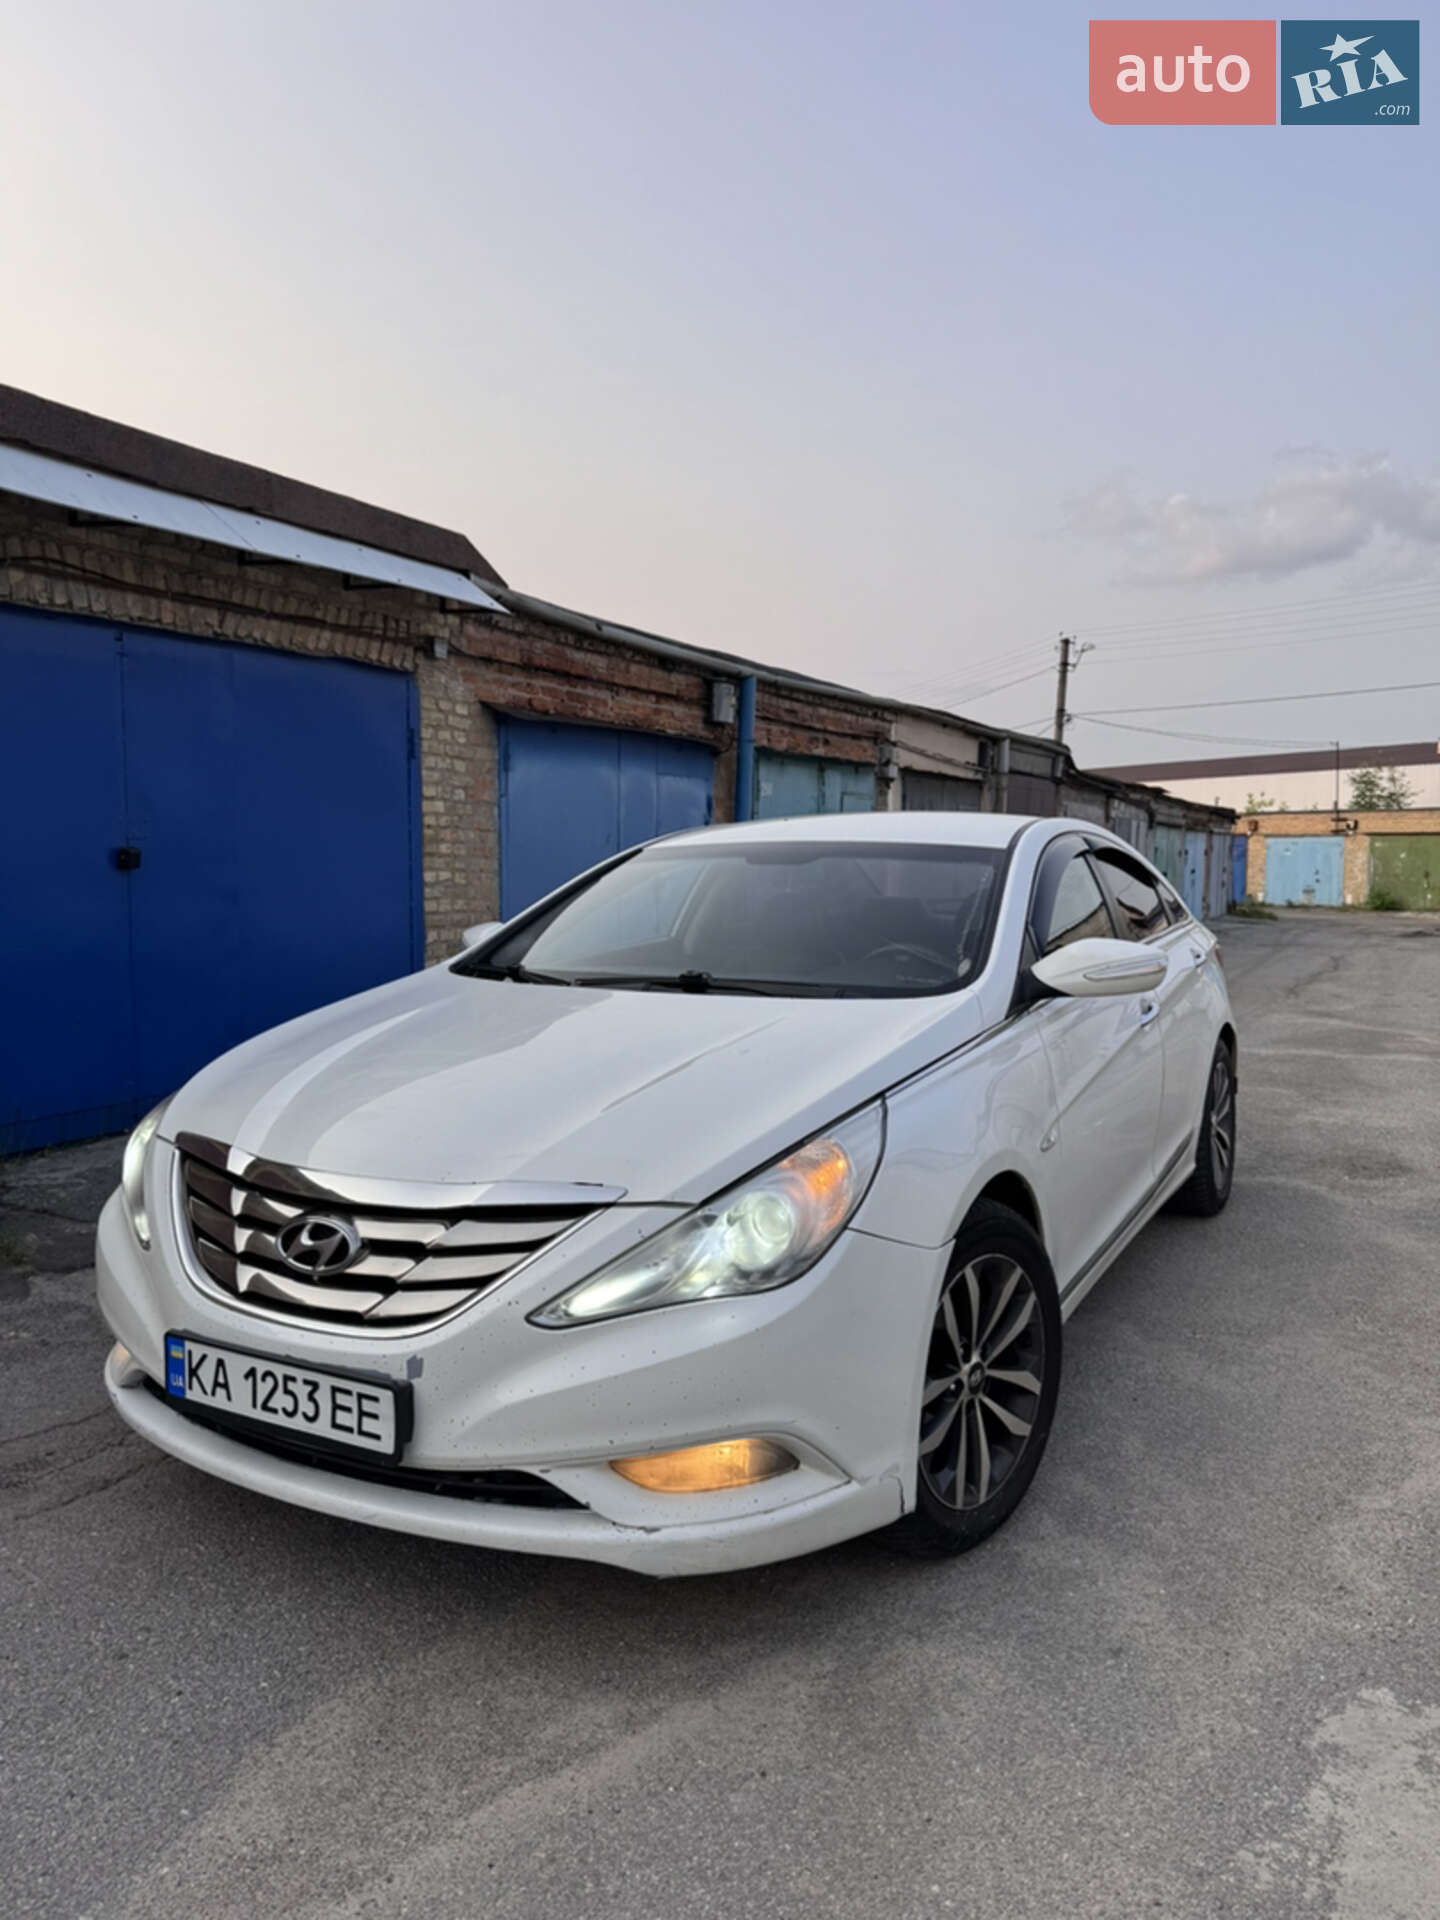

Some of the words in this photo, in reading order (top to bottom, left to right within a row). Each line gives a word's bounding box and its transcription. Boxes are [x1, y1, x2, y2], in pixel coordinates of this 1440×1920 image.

[170, 1372, 184, 1388] UA
[187, 1349, 232, 1402] KA
[243, 1366, 320, 1424] 1253
[330, 1385, 382, 1441] EE
